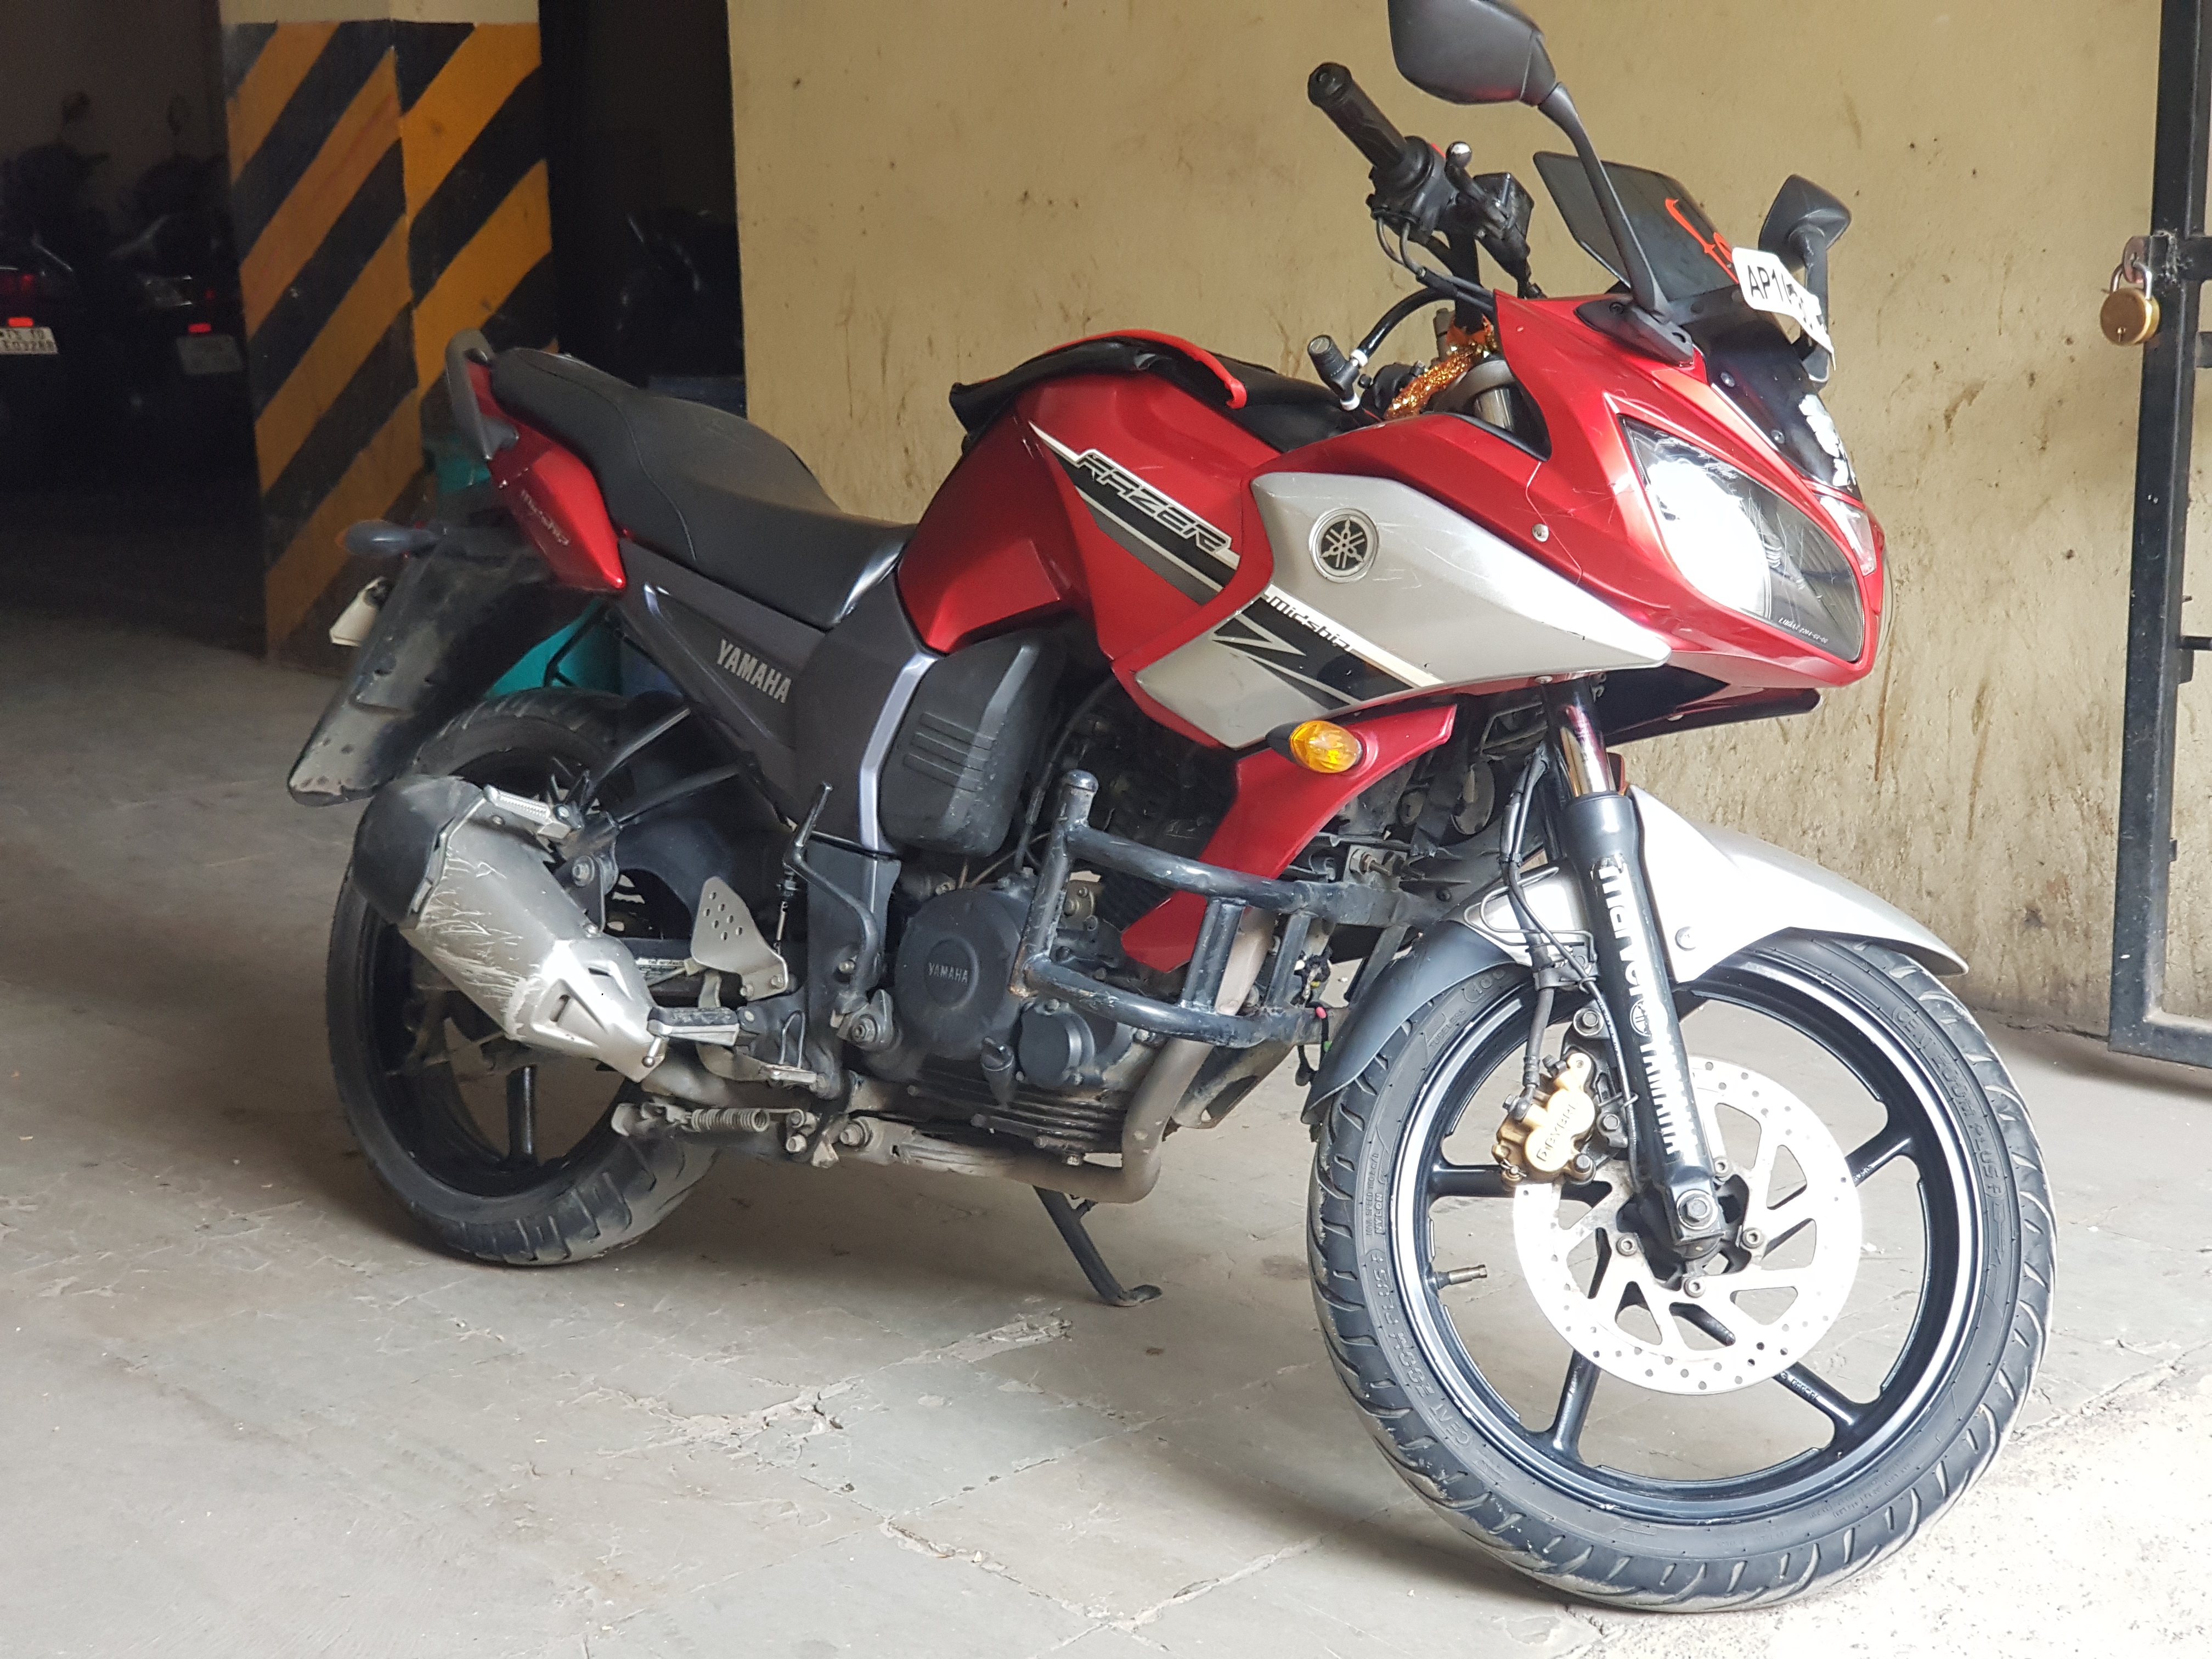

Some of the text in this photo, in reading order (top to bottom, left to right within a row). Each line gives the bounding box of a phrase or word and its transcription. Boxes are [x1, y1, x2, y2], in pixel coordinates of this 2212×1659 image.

[716, 639, 792, 704] YAMAHA
[929, 962, 968, 983] YAMAHA
[1428, 1008, 1466, 1047] TUBELESS
[1640, 1034, 1699, 1155] YAMAHA
[1967, 1122, 1999, 1178] PLUS
[1365, 1192, 1374, 1216] SPEED
[1375, 1193, 1385, 1234] NYLON
[1373, 1268, 1400, 1325] PLUS
[1389, 1332, 1436, 1398] ZOOM
[1430, 1403, 1471, 1445] CEAT
